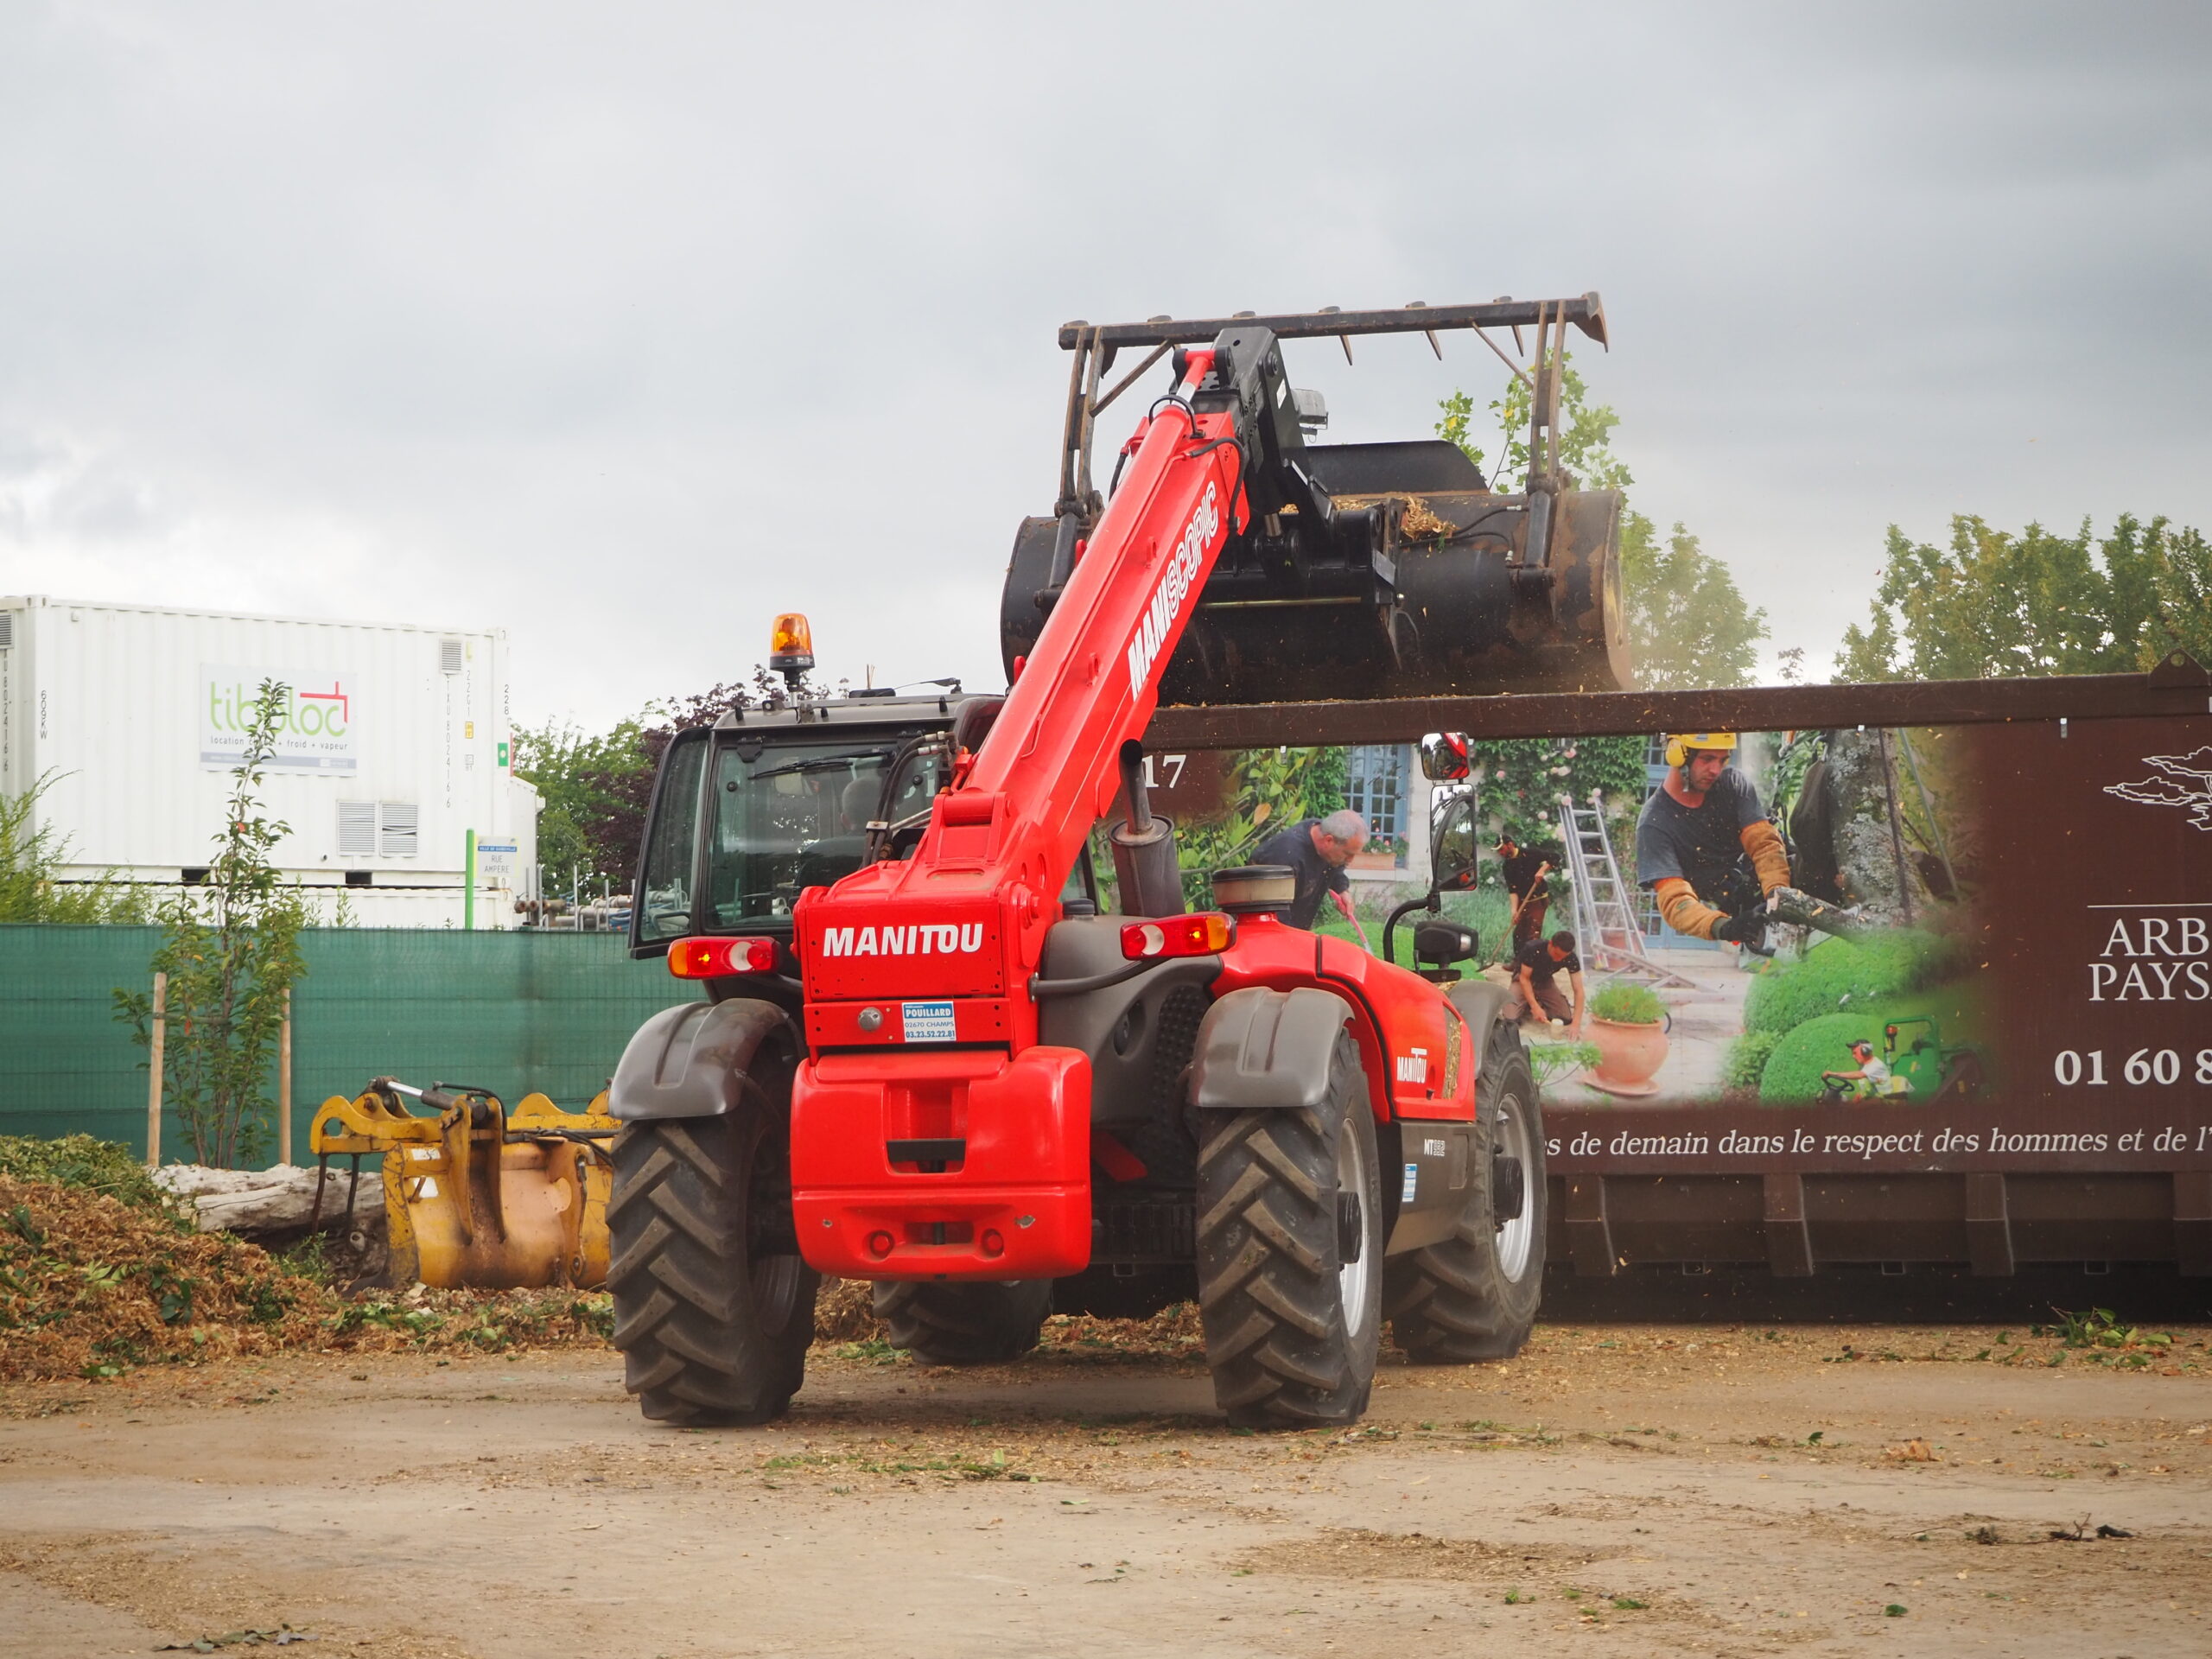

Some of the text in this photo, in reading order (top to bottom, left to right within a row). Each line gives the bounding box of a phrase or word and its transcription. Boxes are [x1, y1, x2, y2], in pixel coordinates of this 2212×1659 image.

[1128, 480, 1218, 702] MANISCOPIC
[211, 736, 245, 745] location
[287, 740, 307, 748] froid
[1142, 754, 1187, 788] 17
[823, 924, 982, 957] MANITOU
[2100, 918, 2209, 957] ARB
[2088, 961, 2212, 1001] PAYS
[906, 1008, 951, 1017] POUILLARD
[1396, 1047, 1427, 1084] MANITOU
[2054, 1050, 2108, 1085] 01
[2124, 1048, 2181, 1085] 60
[1545, 1138, 1560, 1156] s
[1570, 1131, 1601, 1156] de
[1610, 1131, 1709, 1155] demain
[1719, 1129, 1784, 1154] dans
[1790, 1128, 1815, 1153] le
[1822, 1128, 1923, 1160] respect
[1932, 1128, 1980, 1153] des
[1987, 1127, 2108, 1153] hommes
[2117, 1128, 2145, 1152] et
[2153, 1127, 2187, 1152] de
